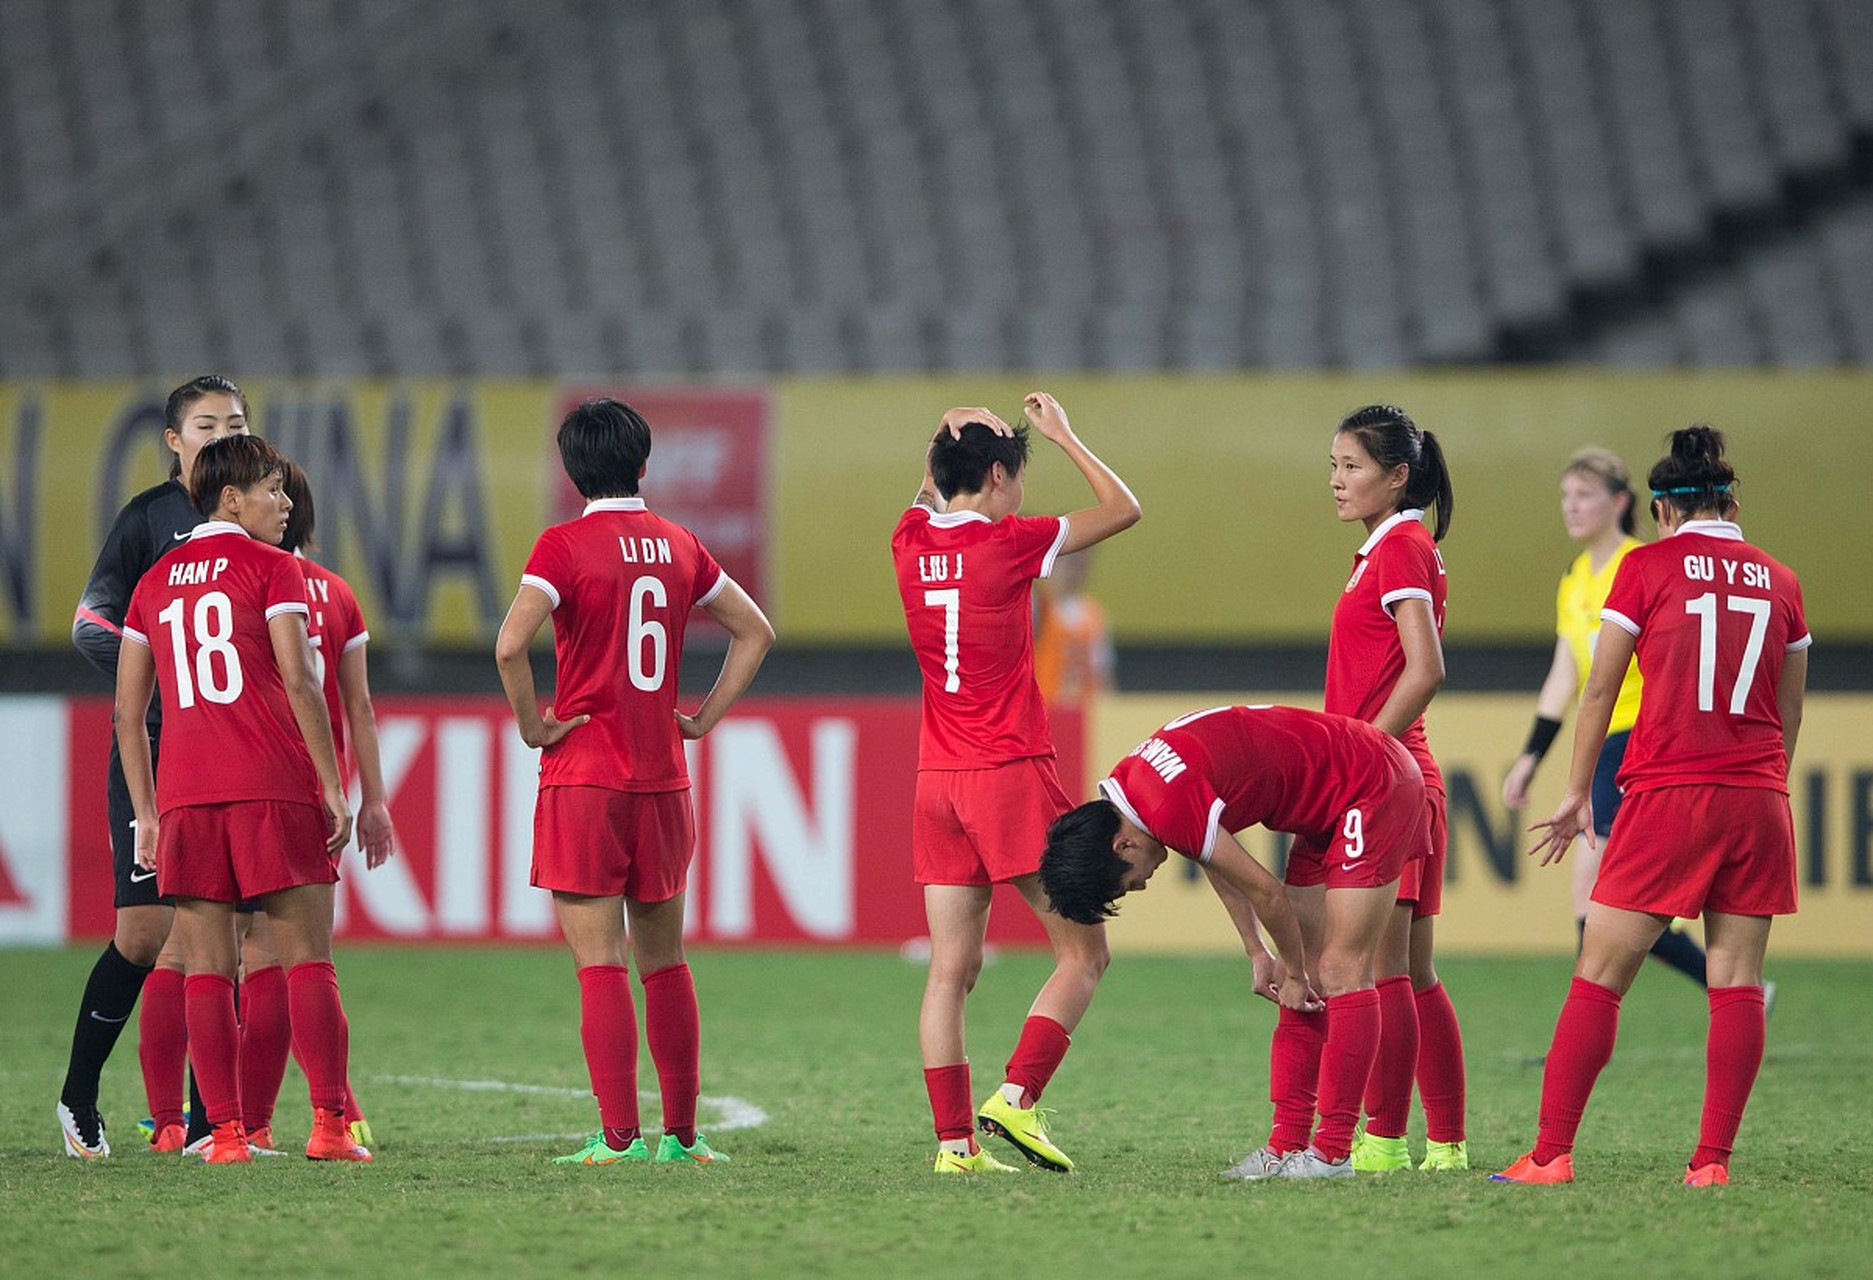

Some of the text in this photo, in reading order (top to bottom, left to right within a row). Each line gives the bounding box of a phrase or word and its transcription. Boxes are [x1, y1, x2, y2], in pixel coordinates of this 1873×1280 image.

[167, 557, 229, 586] HAN P
[618, 536, 672, 564] LI DN
[918, 552, 963, 582] LIU J
[1683, 554, 1771, 591] GU Y SH
[158, 590, 244, 710] 18
[627, 575, 668, 693] 6
[924, 588, 961, 694] 7
[1685, 592, 1772, 714] 17
[1343, 808, 1364, 859] 9
